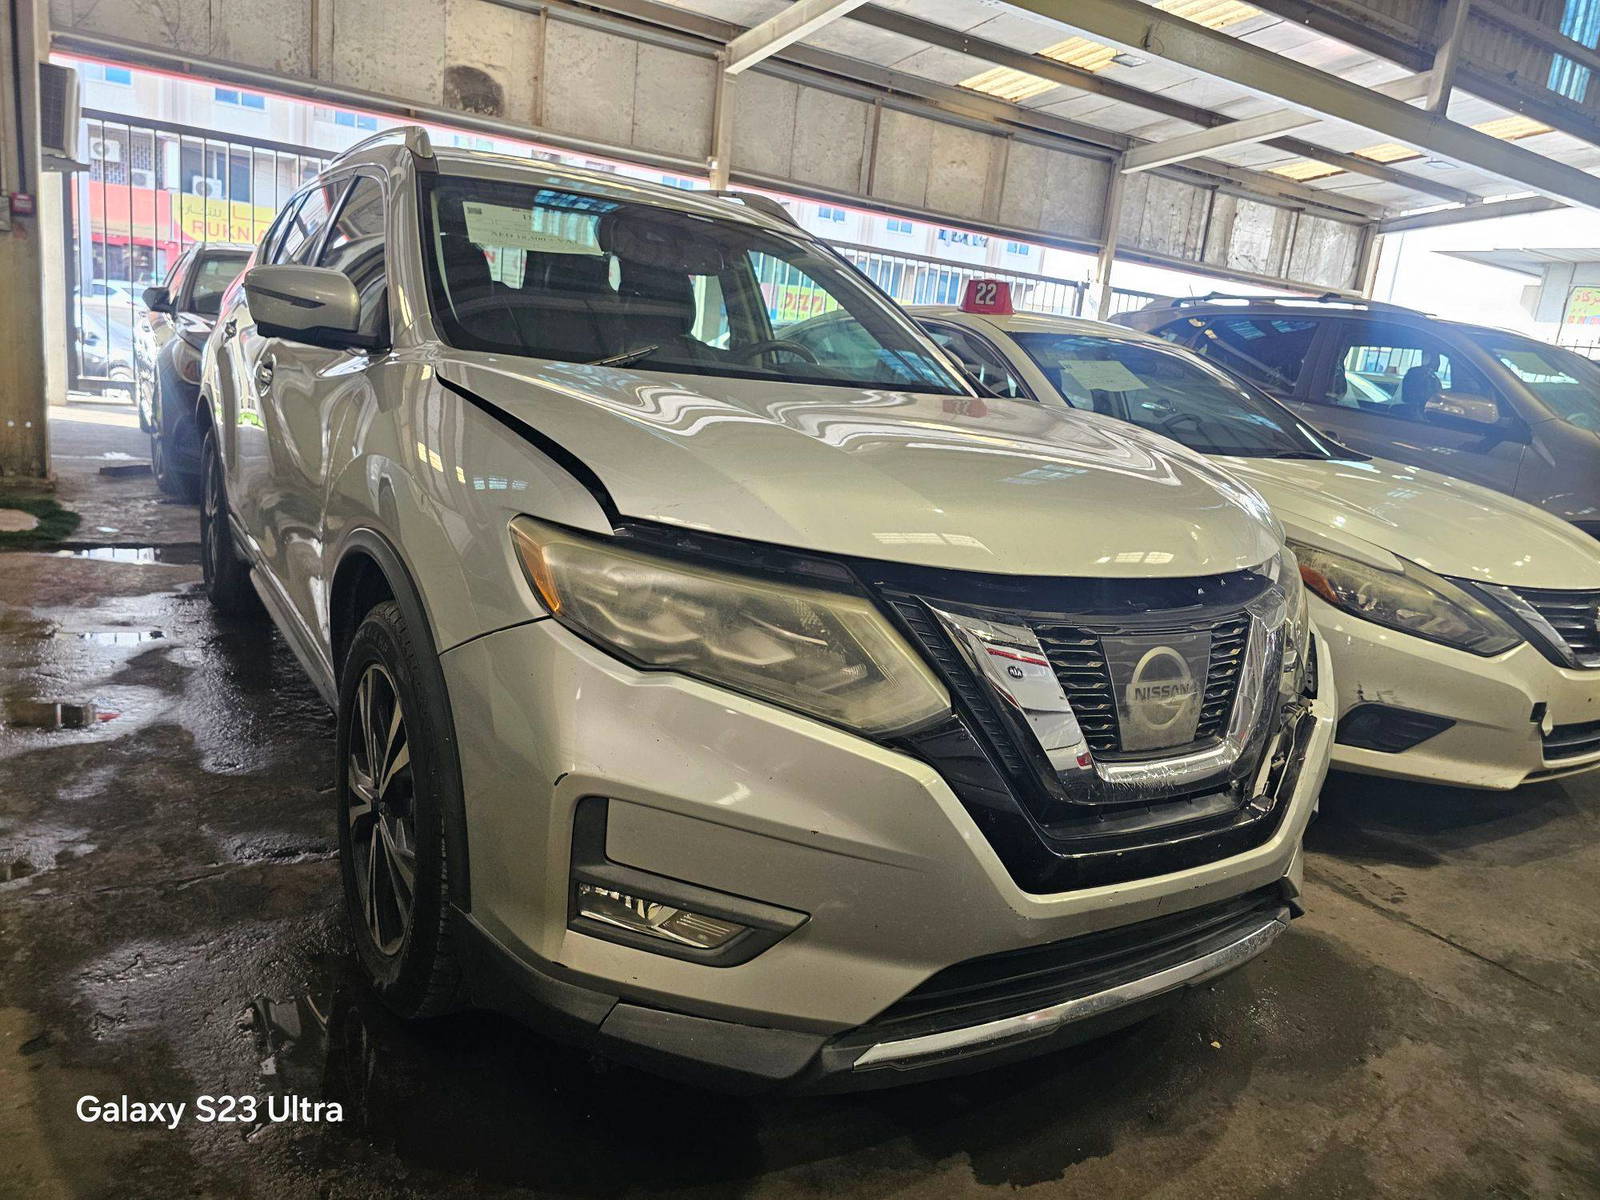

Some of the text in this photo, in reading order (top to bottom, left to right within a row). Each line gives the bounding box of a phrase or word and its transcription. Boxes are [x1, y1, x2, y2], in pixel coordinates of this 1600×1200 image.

[192, 219, 250, 241] RUKN
[975, 282, 997, 305] 22
[1135, 683, 1190, 701] NISSAN
